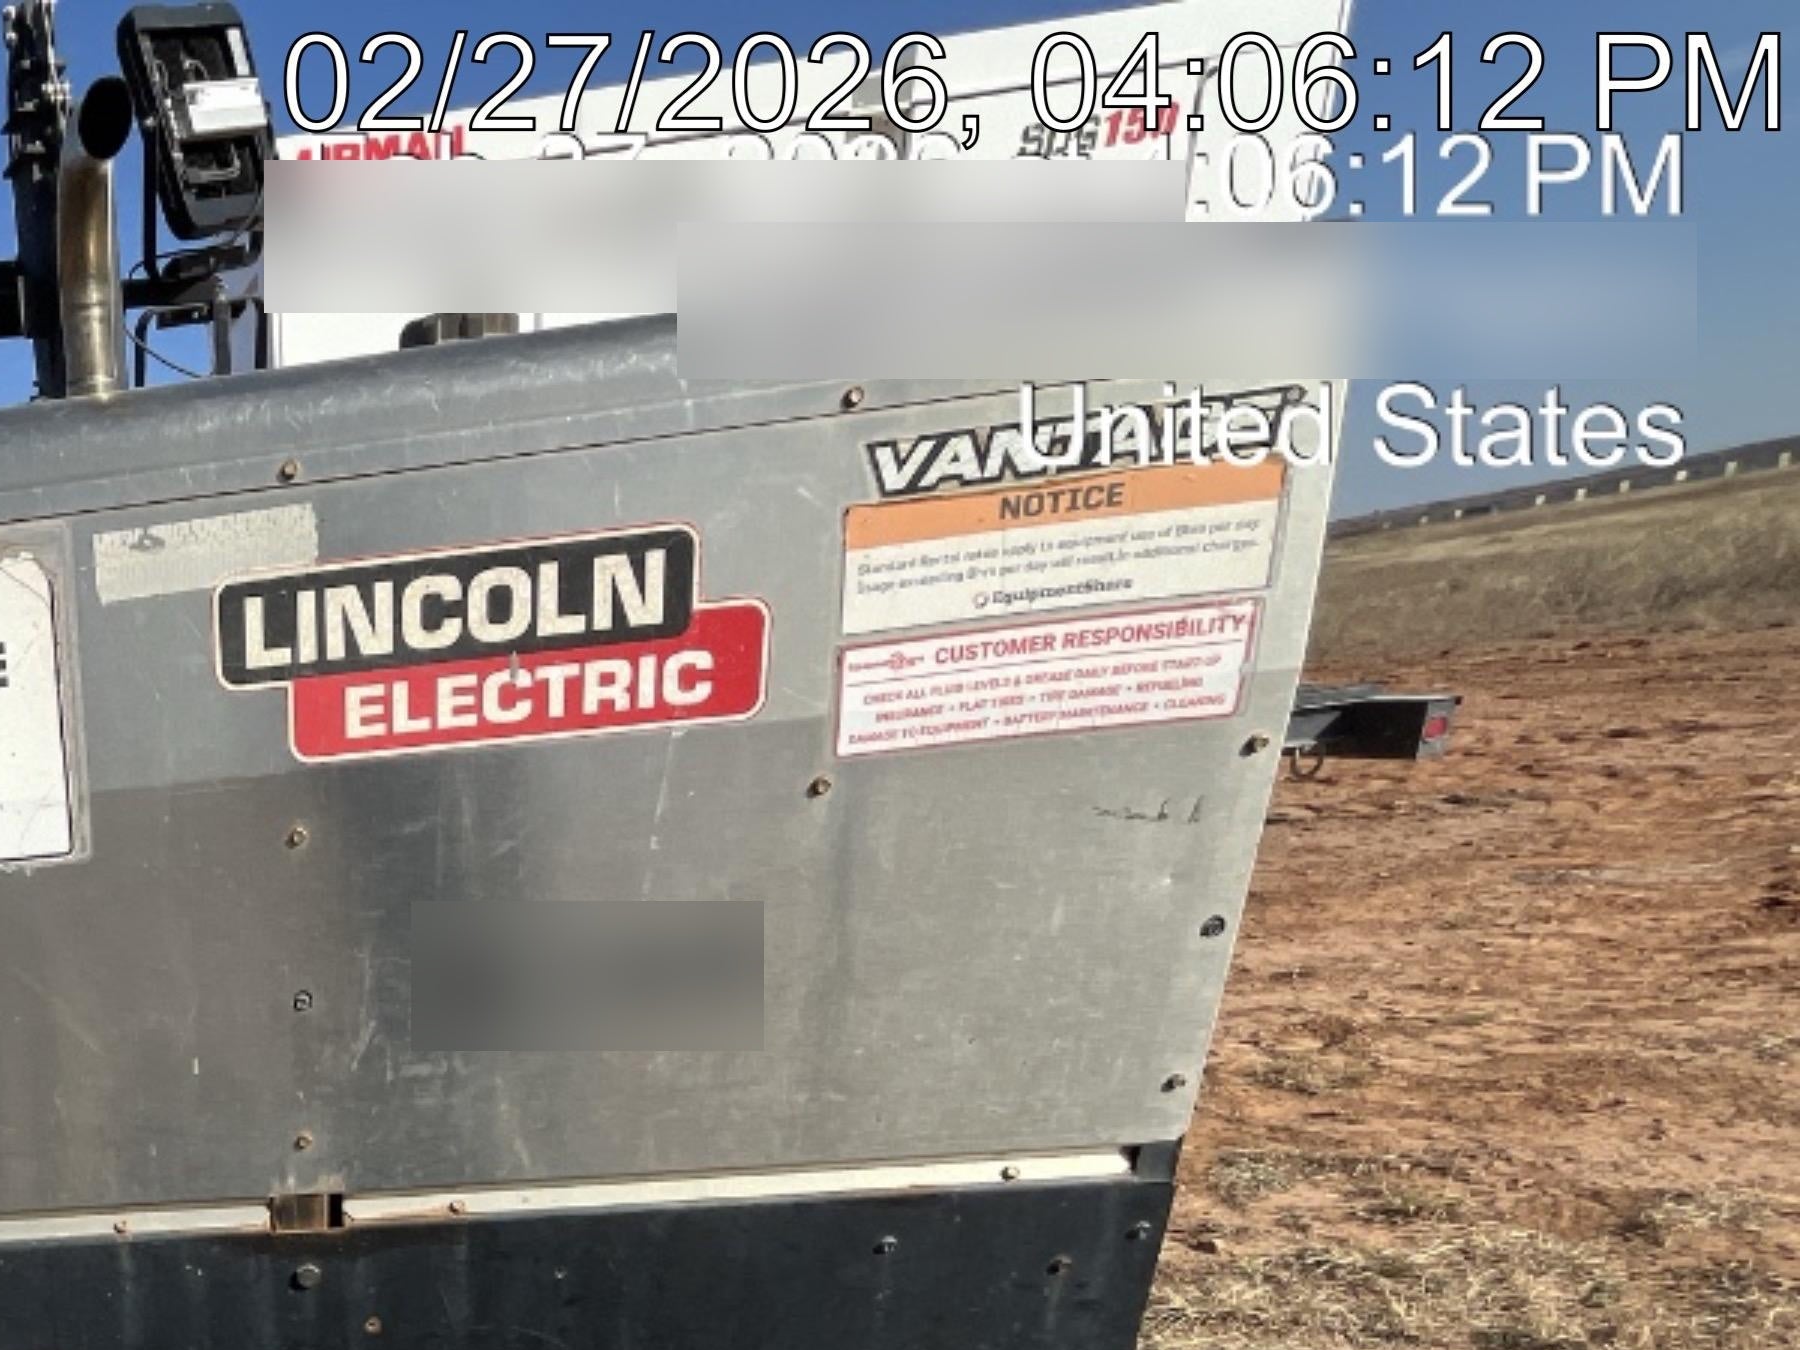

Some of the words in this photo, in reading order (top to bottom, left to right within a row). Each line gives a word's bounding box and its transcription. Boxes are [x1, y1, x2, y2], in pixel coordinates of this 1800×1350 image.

[998, 481, 1125, 520] NOTICE
[243, 548, 667, 670] LINCOLN
[992, 578, 1134, 605] EquipmentShare
[935, 633, 1056, 664] CUSTOMER
[1062, 614, 1247, 649] RESPONSIBILITY
[344, 650, 715, 740] ELECTRIC
